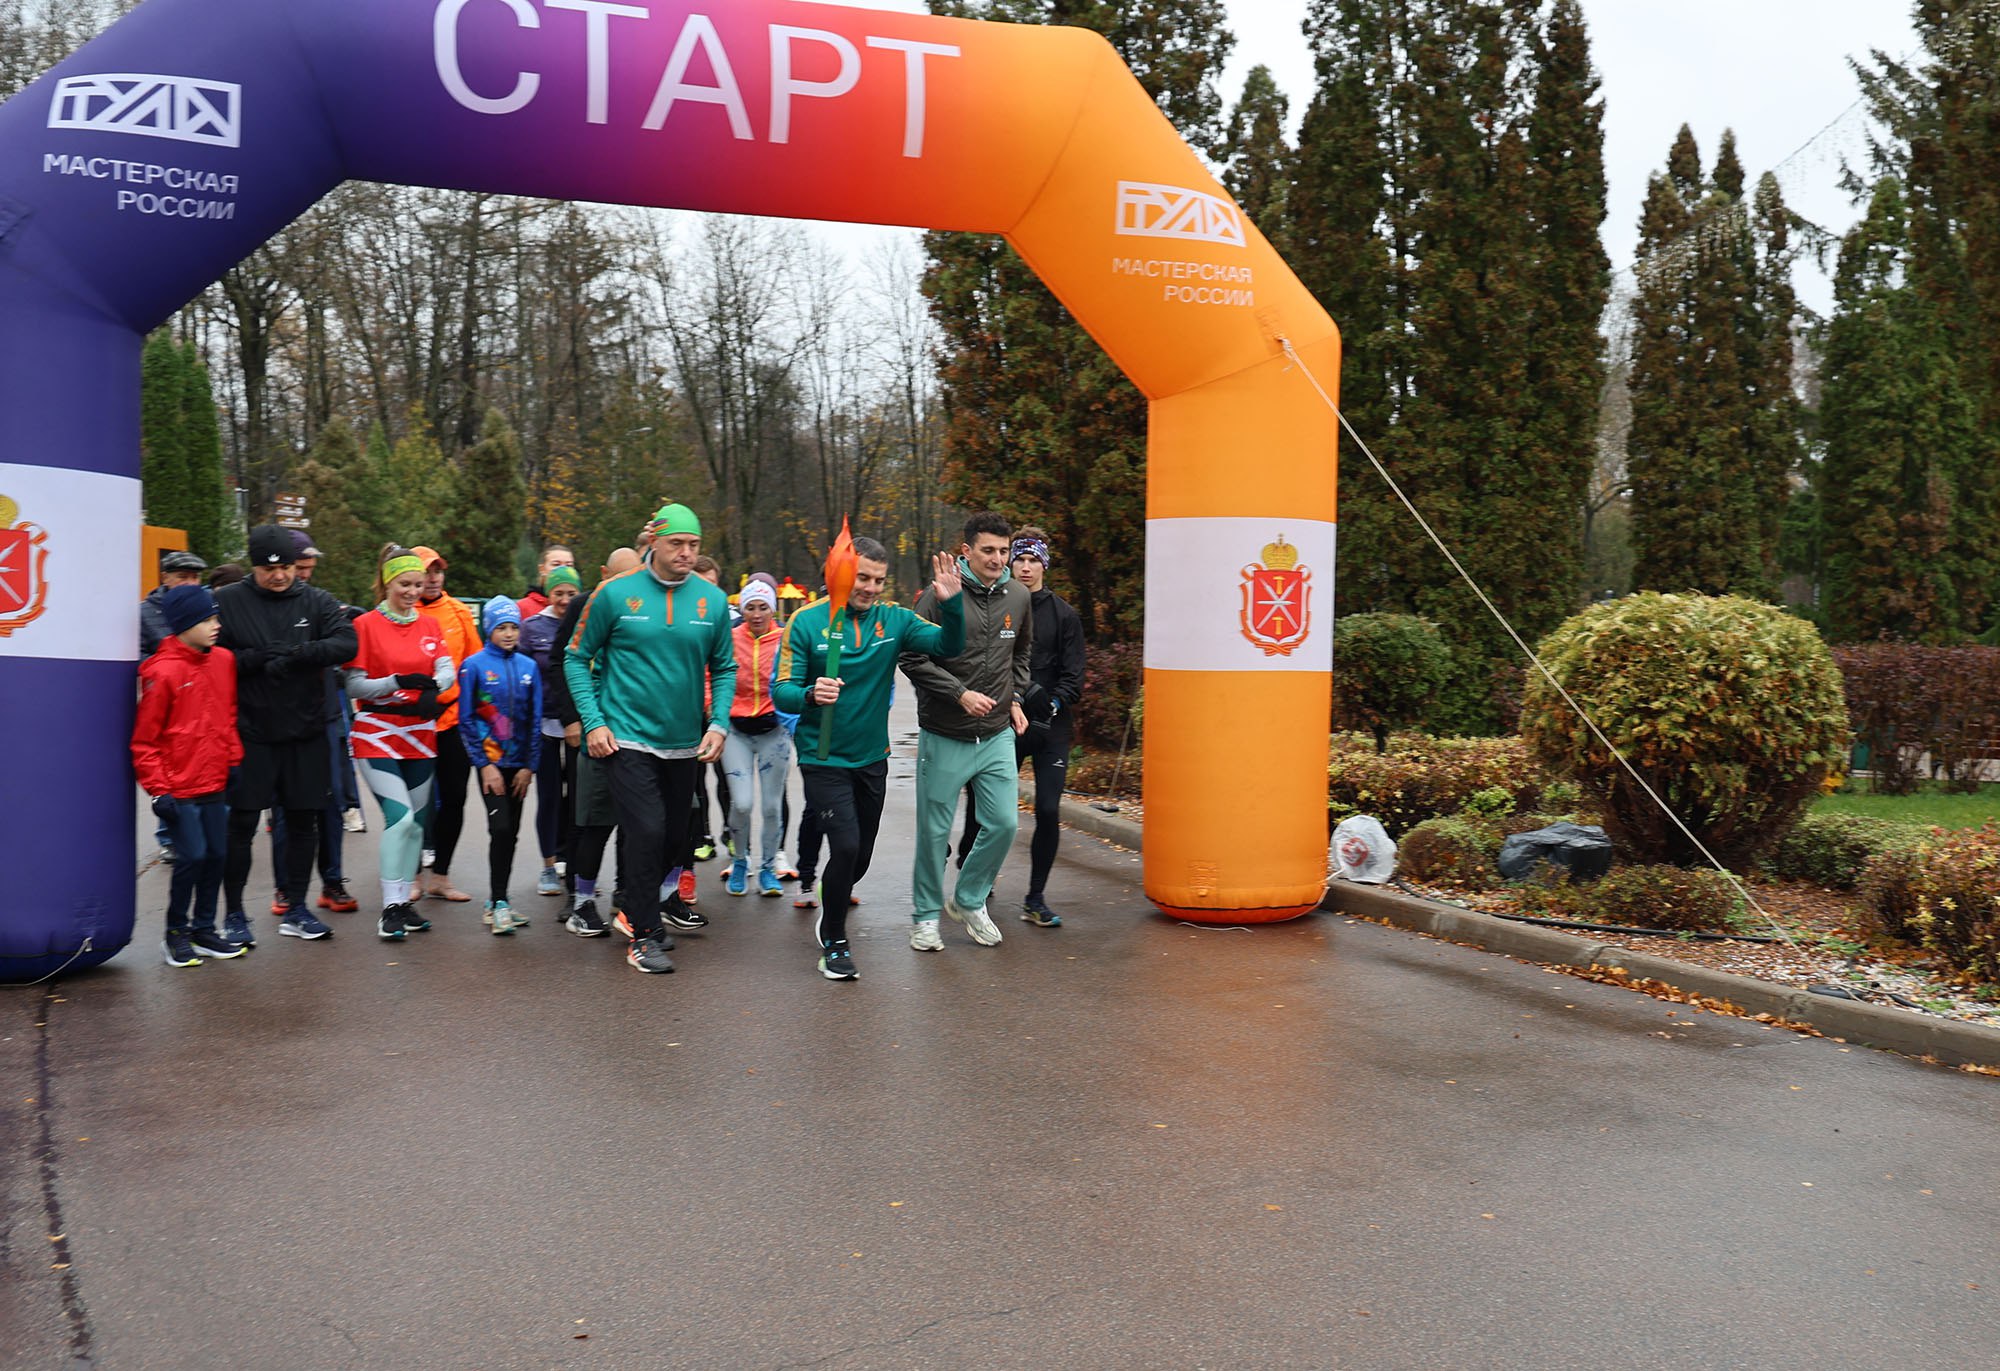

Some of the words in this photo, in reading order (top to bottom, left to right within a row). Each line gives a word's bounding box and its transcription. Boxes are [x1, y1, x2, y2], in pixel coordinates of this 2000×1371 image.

[433, 0, 961, 158] СТАРТ
[43, 153, 240, 194] МАСТЕРСКАЯ
[117, 190, 236, 220] РОССИИ
[1112, 257, 1254, 284] МАСТЕРСКАЯ
[1163, 285, 1255, 307] РОССИИ
